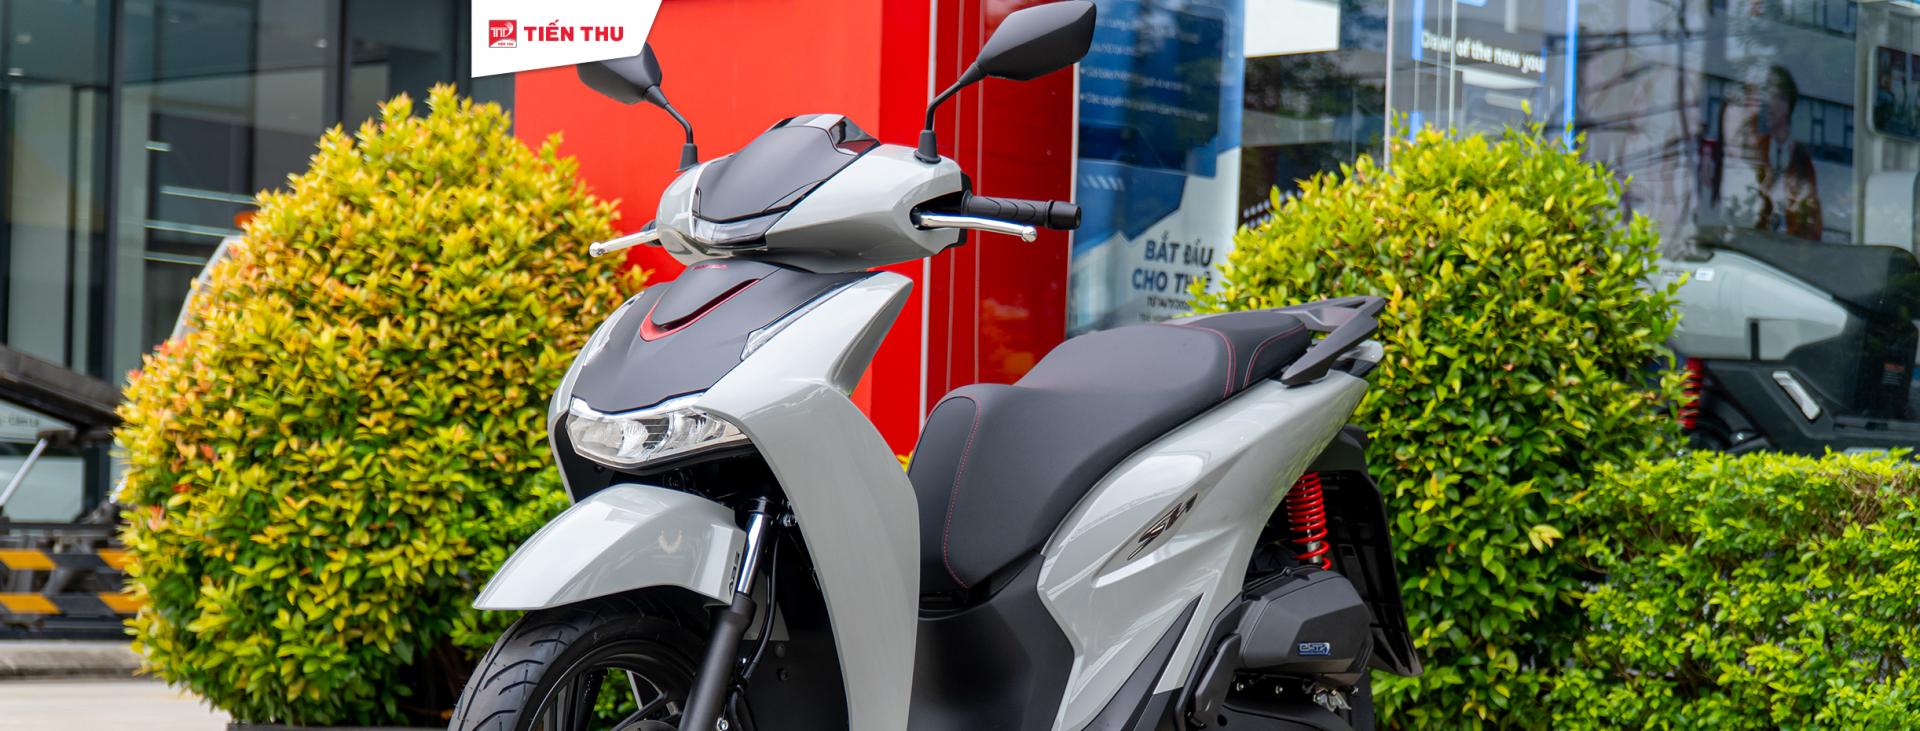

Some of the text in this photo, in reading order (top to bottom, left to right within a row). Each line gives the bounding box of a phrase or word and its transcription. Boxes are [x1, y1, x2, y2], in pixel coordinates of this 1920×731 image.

[1456, 37, 1471, 58] of
[1471, 39, 1493, 62] the
[1494, 47, 1521, 67] new
[1521, 53, 1546, 74] you
[1132, 267, 1168, 293] CHO
